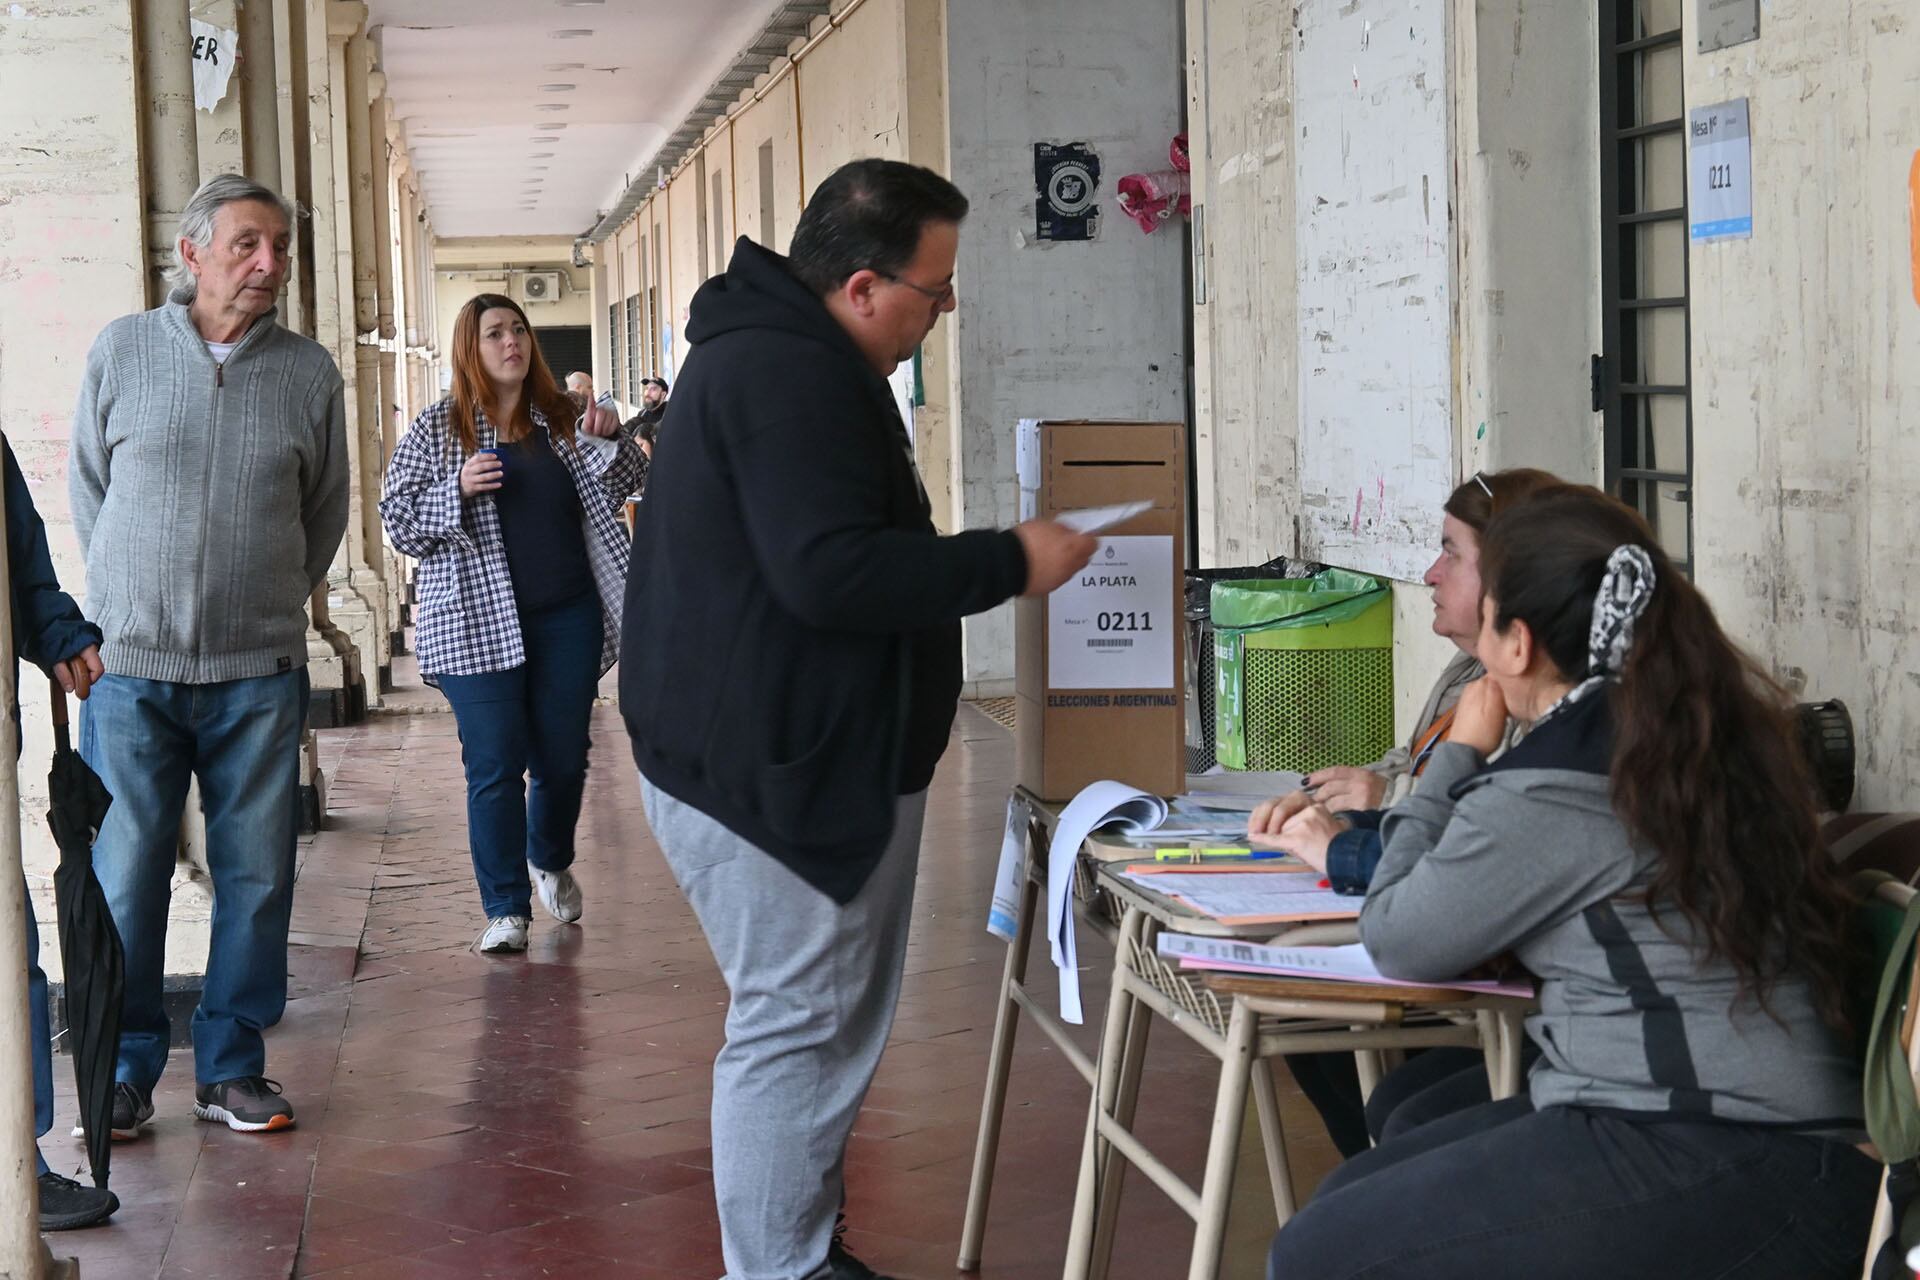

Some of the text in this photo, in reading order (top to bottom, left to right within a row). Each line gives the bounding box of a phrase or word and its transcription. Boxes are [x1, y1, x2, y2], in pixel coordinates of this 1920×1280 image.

[1082, 576, 1137, 587] LA PLATA
[1097, 611, 1153, 631] 0211
[1048, 694, 1177, 707] ELECCIONES ARGENTINAS
